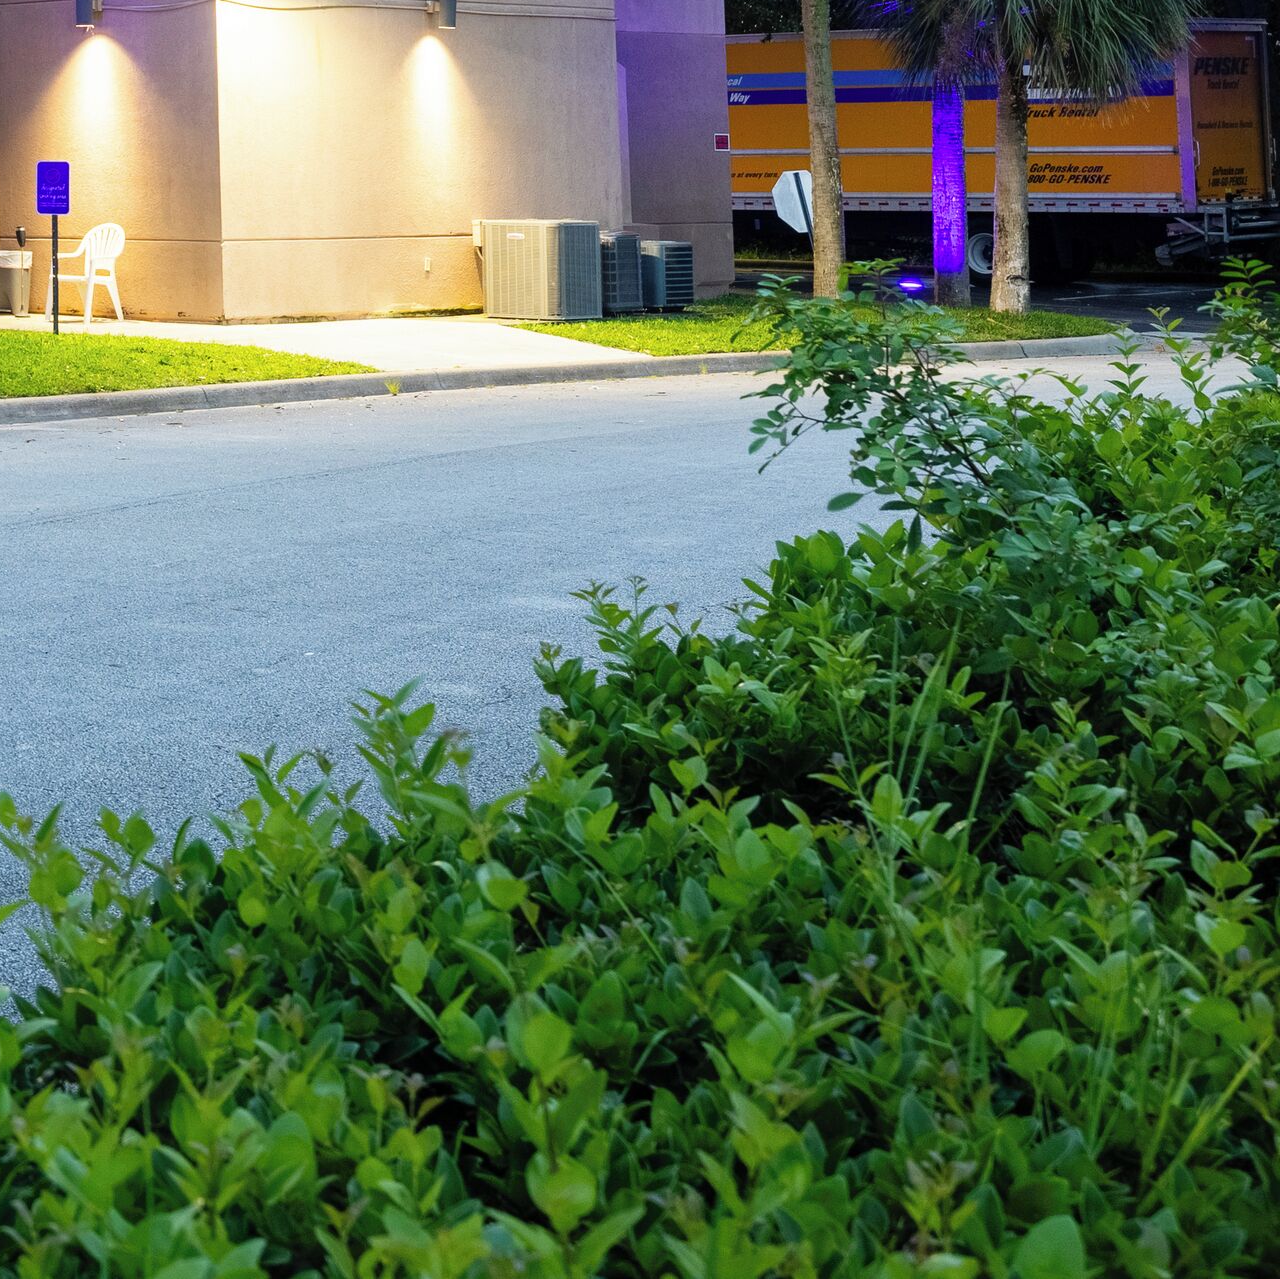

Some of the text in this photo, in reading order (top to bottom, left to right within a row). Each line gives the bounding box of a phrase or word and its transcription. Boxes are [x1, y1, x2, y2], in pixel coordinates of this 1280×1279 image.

[1194, 57, 1250, 75] PENSKE
[727, 76, 743, 86] cal
[729, 92, 751, 104] Way
[1029, 163, 1104, 173] GoPenske.com
